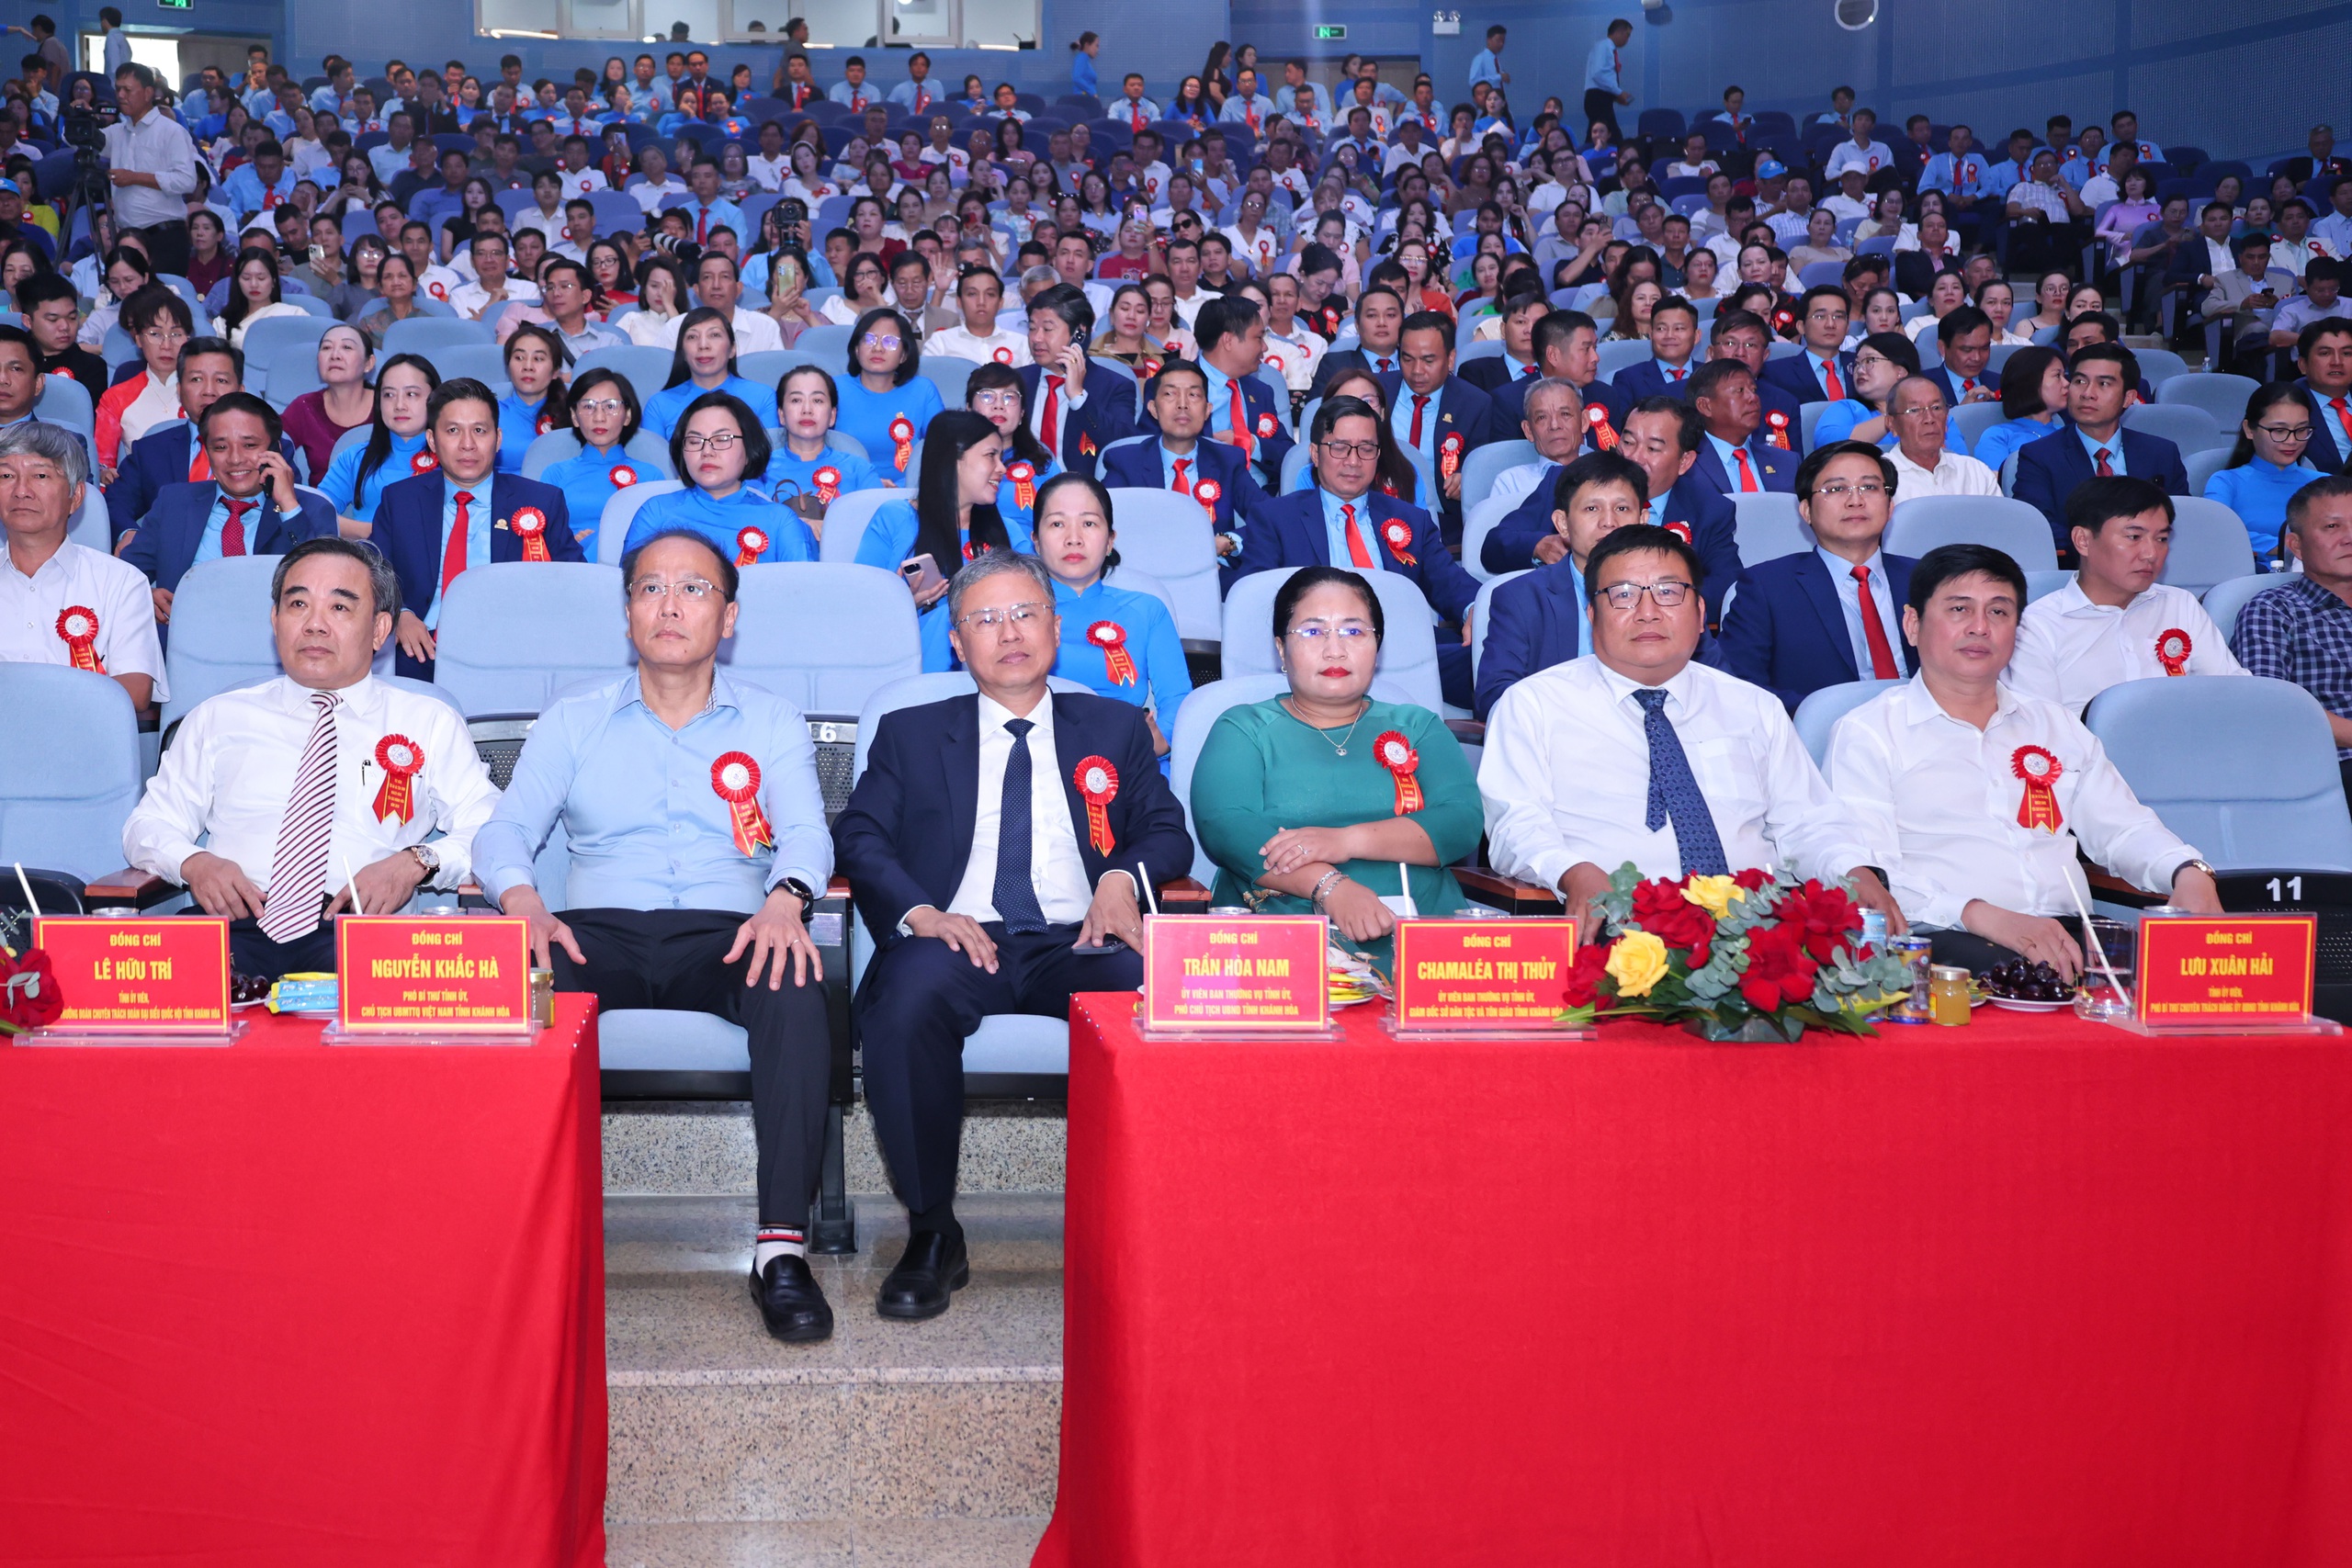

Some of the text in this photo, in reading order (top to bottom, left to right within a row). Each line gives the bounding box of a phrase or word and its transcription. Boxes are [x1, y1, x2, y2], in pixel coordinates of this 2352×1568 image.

[820, 721, 837, 743] 6
[2266, 875, 2301, 902] 11
[143, 931, 161, 947] CHÍ
[445, 931, 462, 945] CHÍ
[1240, 931, 1258, 945] CHÍ
[1494, 933, 1511, 948] CHÍ
[2236, 931, 2252, 944] CHÍ
[95, 956, 172, 980] LÊ HỮU TRÍ
[372, 953, 499, 979] NGUYỄN KHẮC HÀ
[1183, 952, 1289, 977] TRẦN HÒA NAM
[1418, 955, 1556, 984] CHAMALÉA THỊ THỦY
[403, 987, 468, 1003] PHÓ BÍ THƯ TỈNH ỦY,
[361, 1003, 510, 1020] CHỦ TỊCH UBMTTQ VIỆT NAM TỈNH KHÁNH HÒA
[1174, 1002, 1299, 1017] PHÓ CHỦ TỊCH UBND TỈNH KHÁNH HÒA
